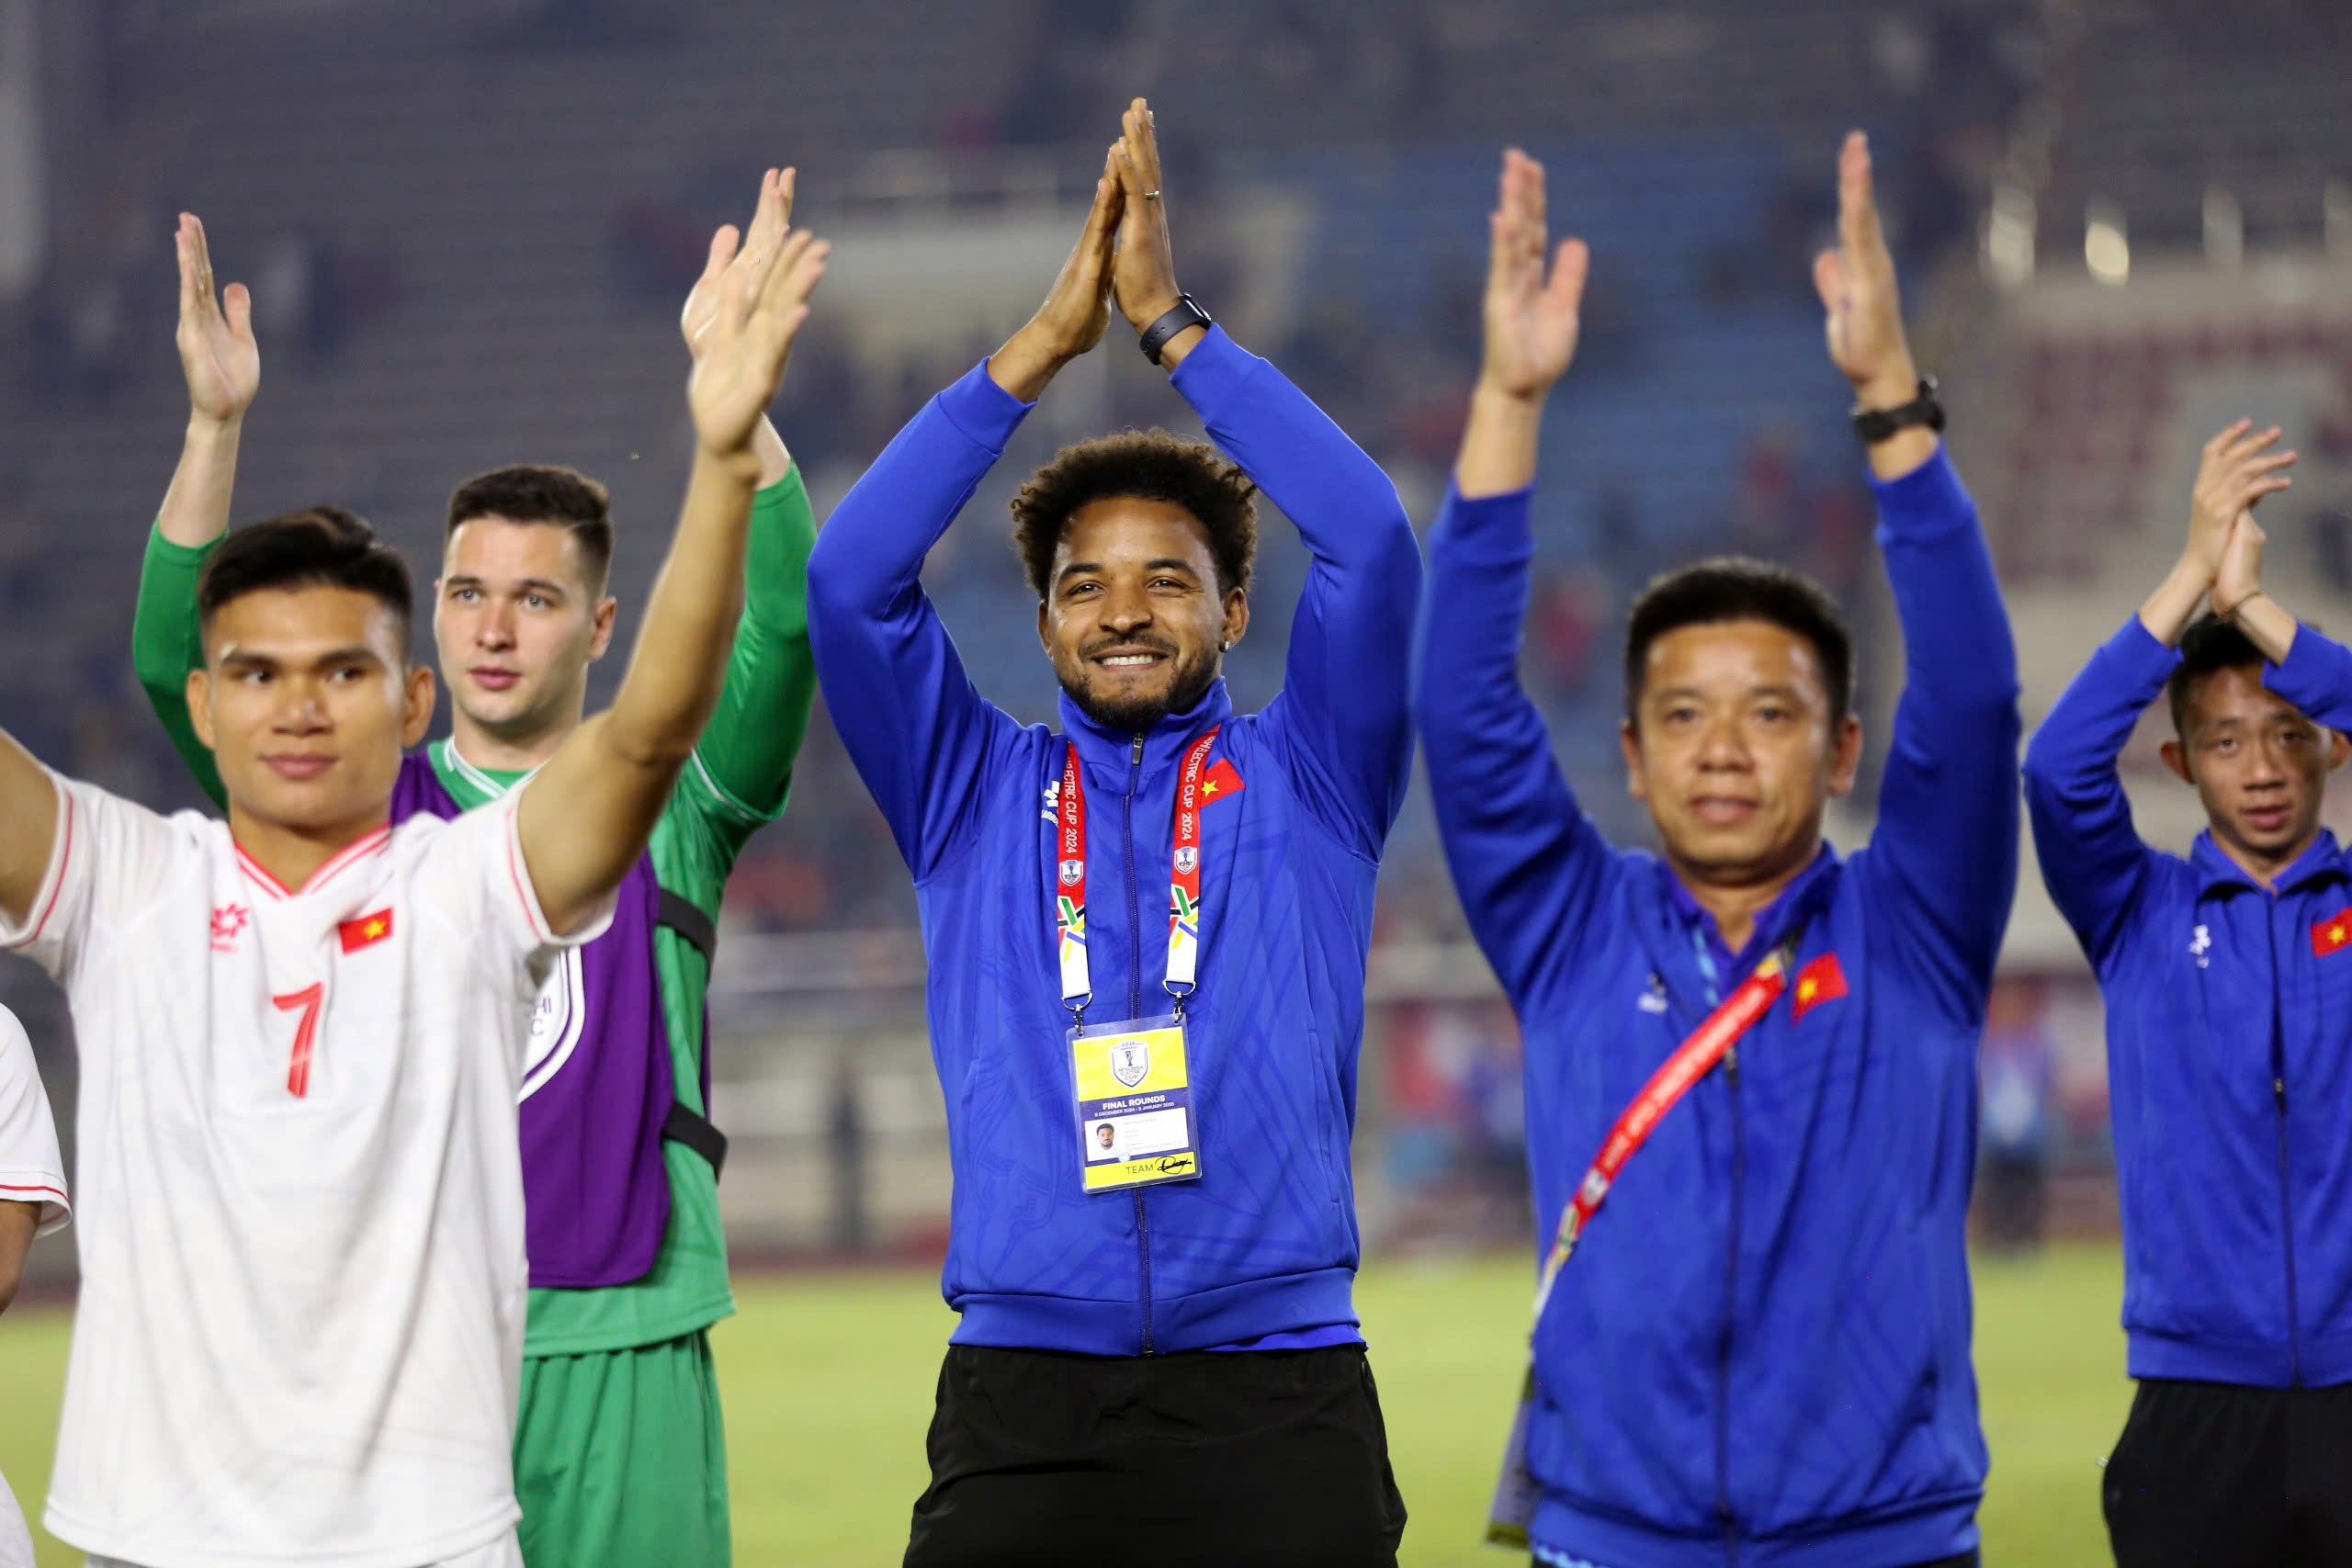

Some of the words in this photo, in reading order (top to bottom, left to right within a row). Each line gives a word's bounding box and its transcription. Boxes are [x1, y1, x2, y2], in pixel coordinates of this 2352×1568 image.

[1186, 747, 1208, 783] ELECTRIC
[1183, 784, 1194, 808] CUP
[1066, 802, 1077, 825] CUP
[1182, 812, 1193, 840] 2024
[1066, 828, 1077, 854] 2024
[273, 981, 322, 1100] 7
[1098, 1109, 1123, 1117] DECEMBER
[1102, 1100, 1127, 1111] FINAL
[1128, 1095, 1166, 1107] ROUNDS
[1125, 1163, 1154, 1175] TEAM
